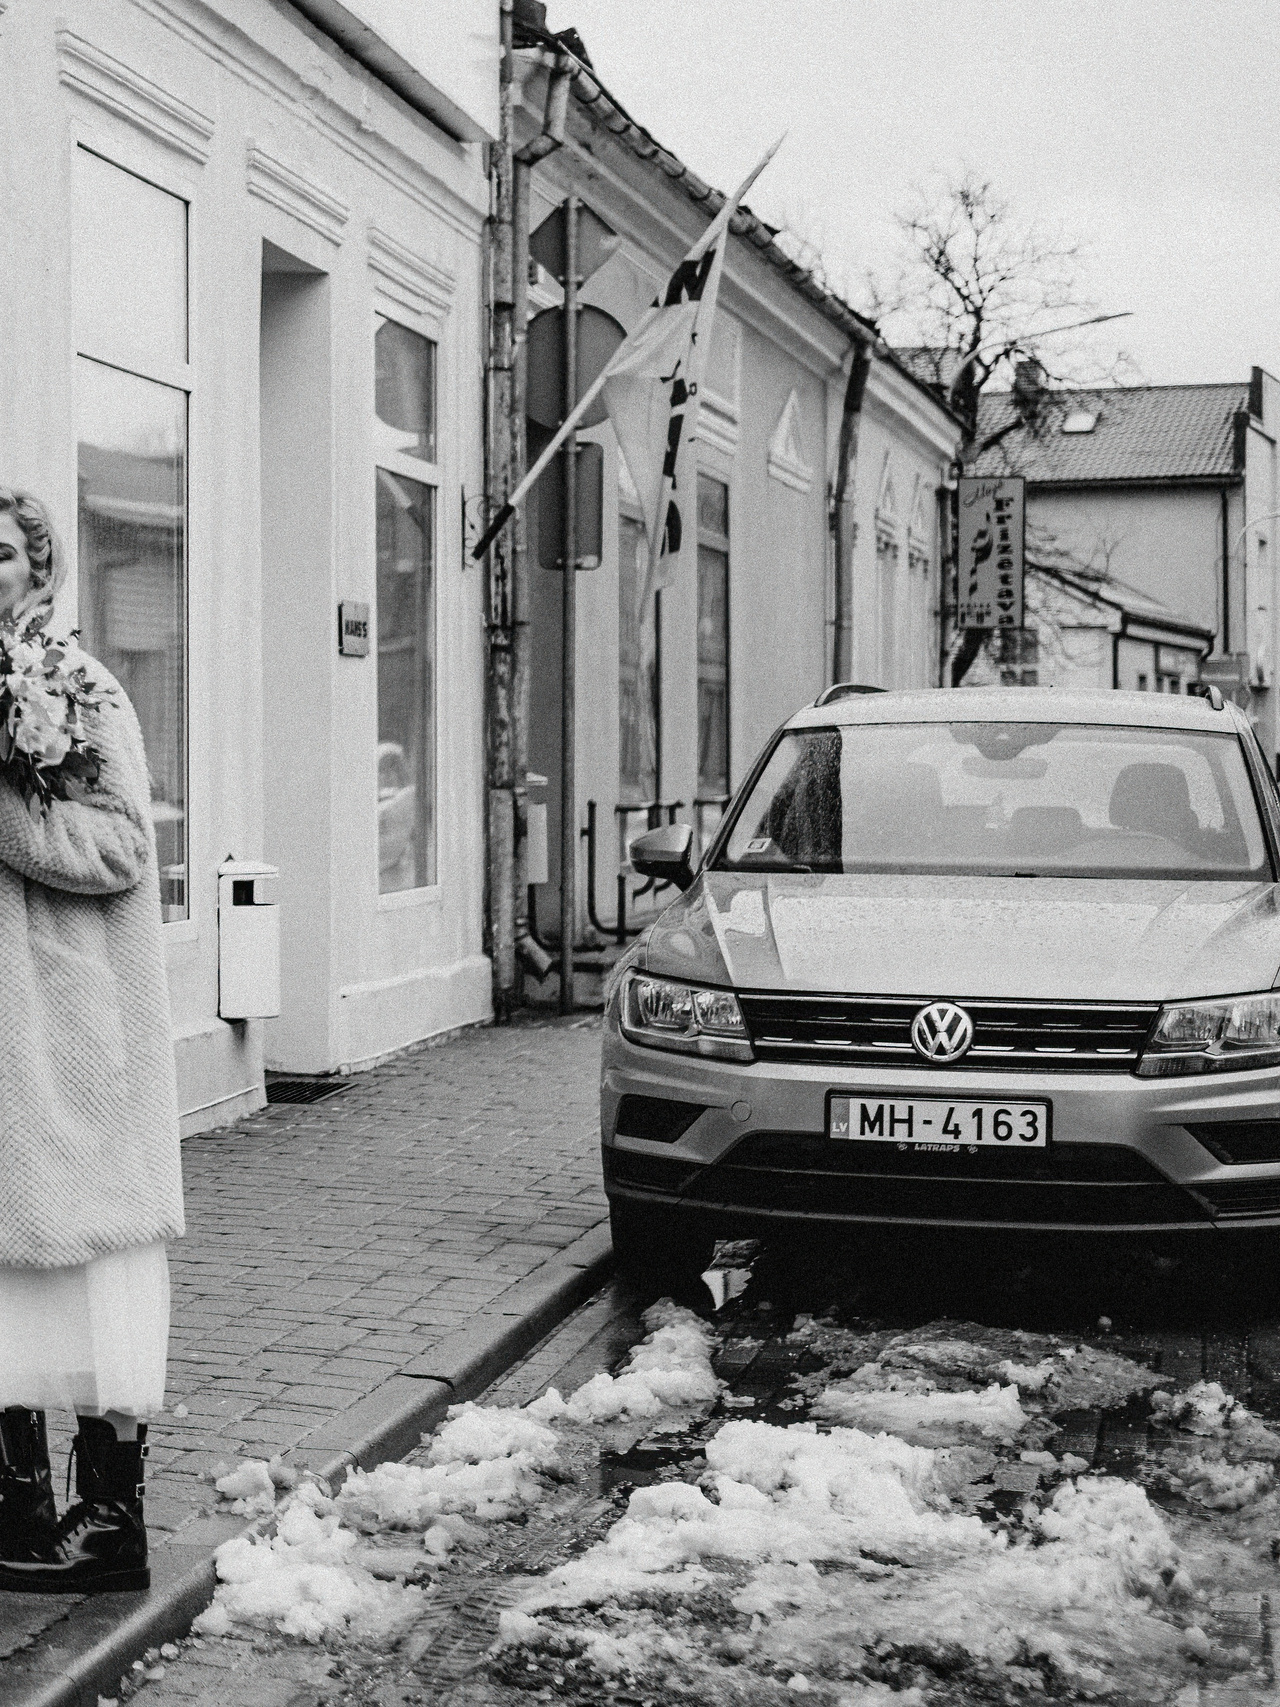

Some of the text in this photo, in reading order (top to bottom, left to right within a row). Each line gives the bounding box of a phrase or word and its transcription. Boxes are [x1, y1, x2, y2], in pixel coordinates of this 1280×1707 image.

[832, 1121, 848, 1133] LV
[859, 1103, 1039, 1142] MH-4163
[914, 1143, 960, 1153] LATRAPS
